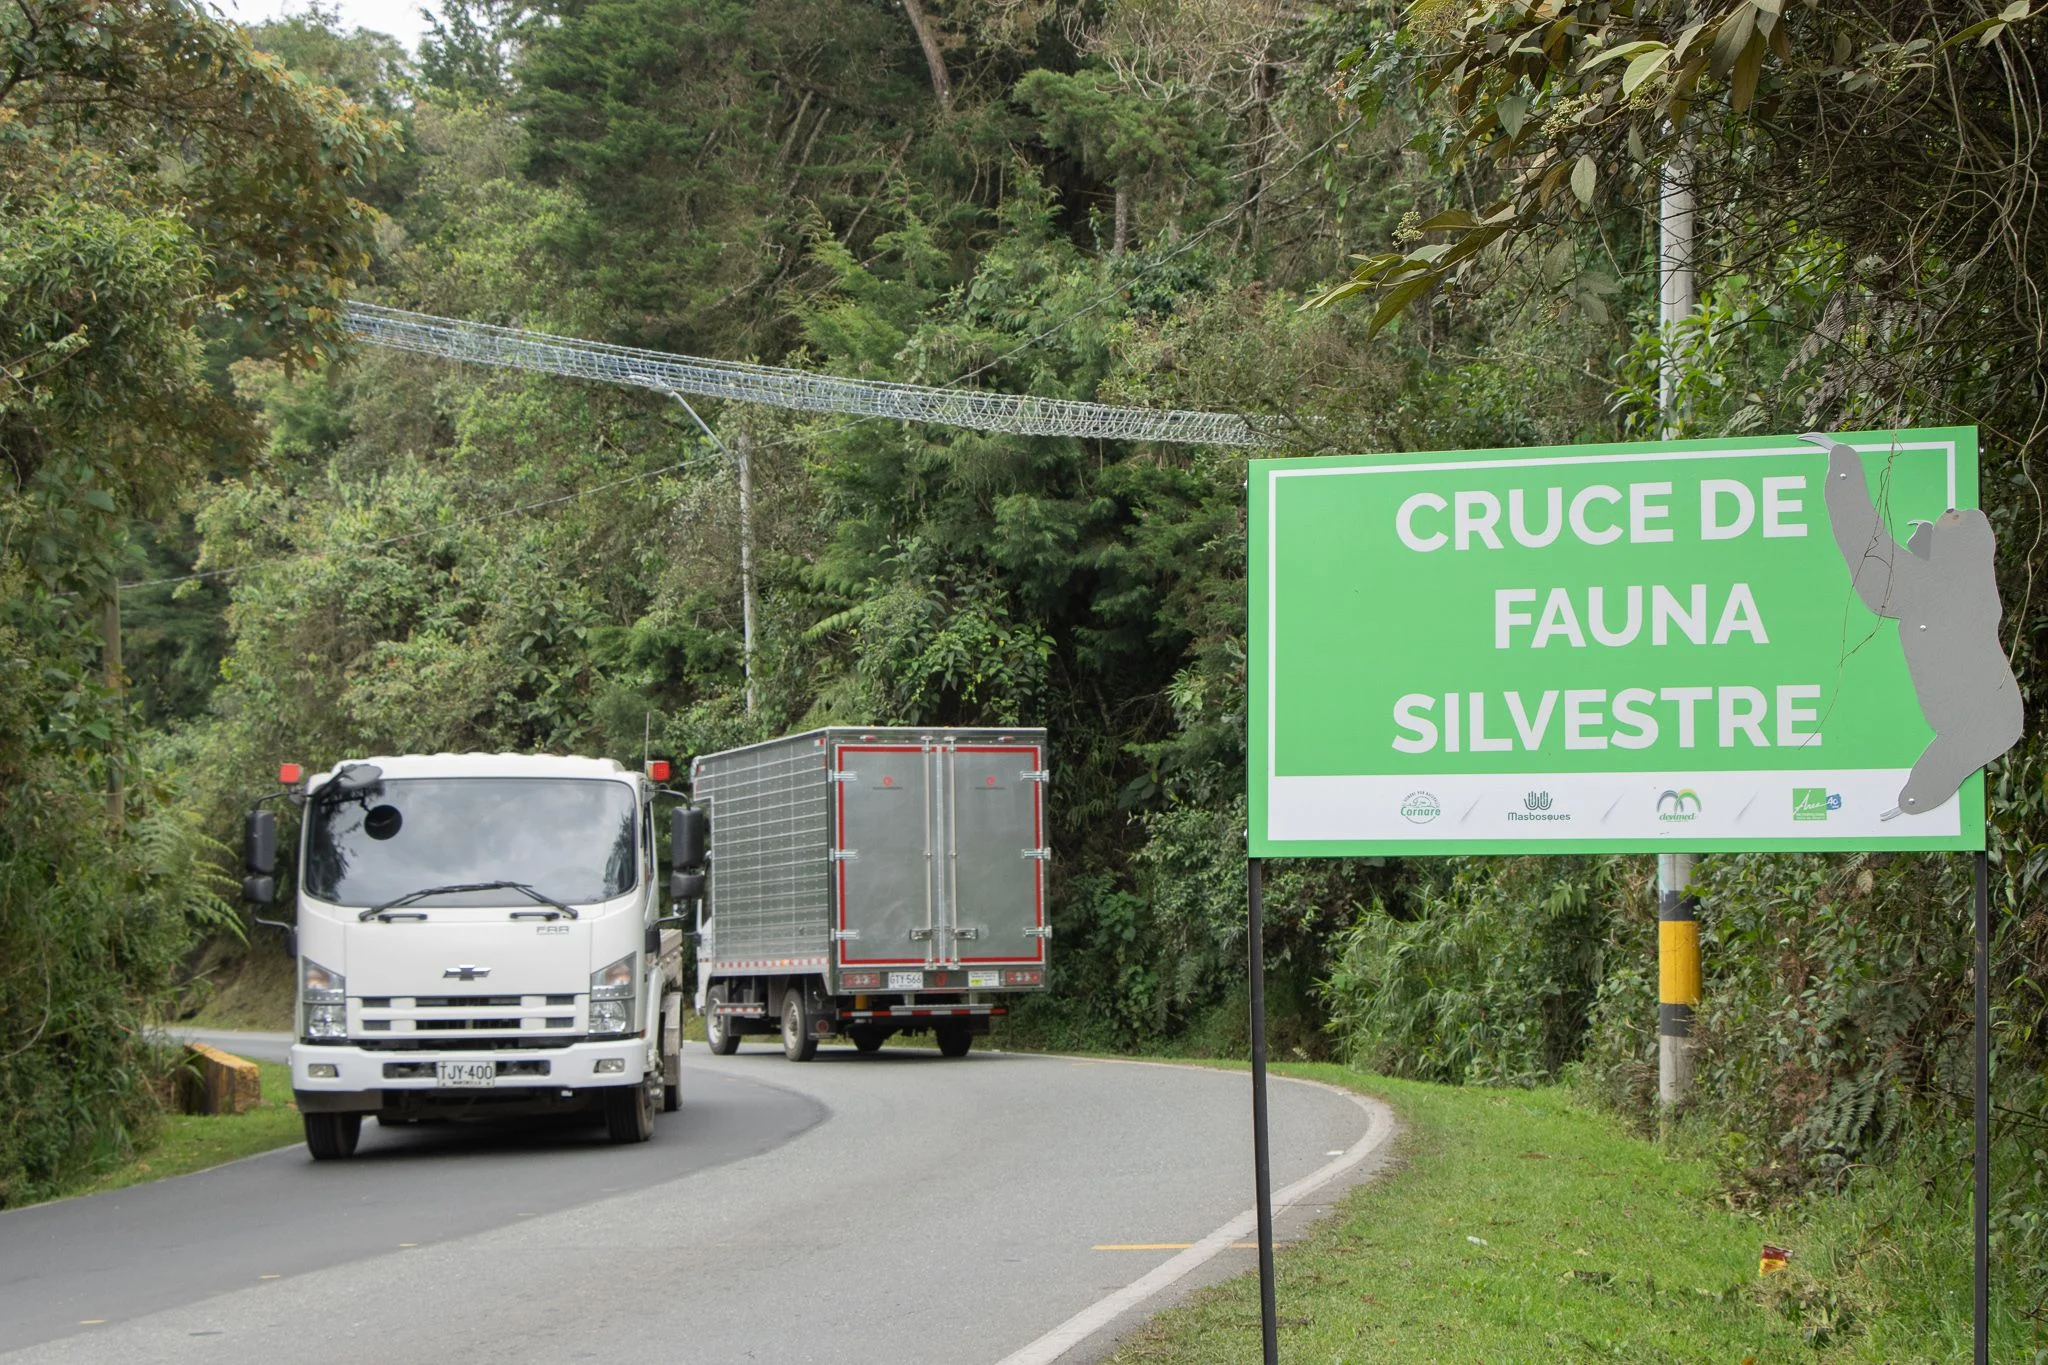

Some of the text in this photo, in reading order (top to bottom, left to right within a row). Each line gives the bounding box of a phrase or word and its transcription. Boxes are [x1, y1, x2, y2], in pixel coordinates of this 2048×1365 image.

[1396, 476, 1808, 553] CRUCE DE
[1495, 583, 1768, 649] FAUNA
[1392, 684, 1822, 754] SILVESTRE
[1400, 806, 1441, 816] Cornare
